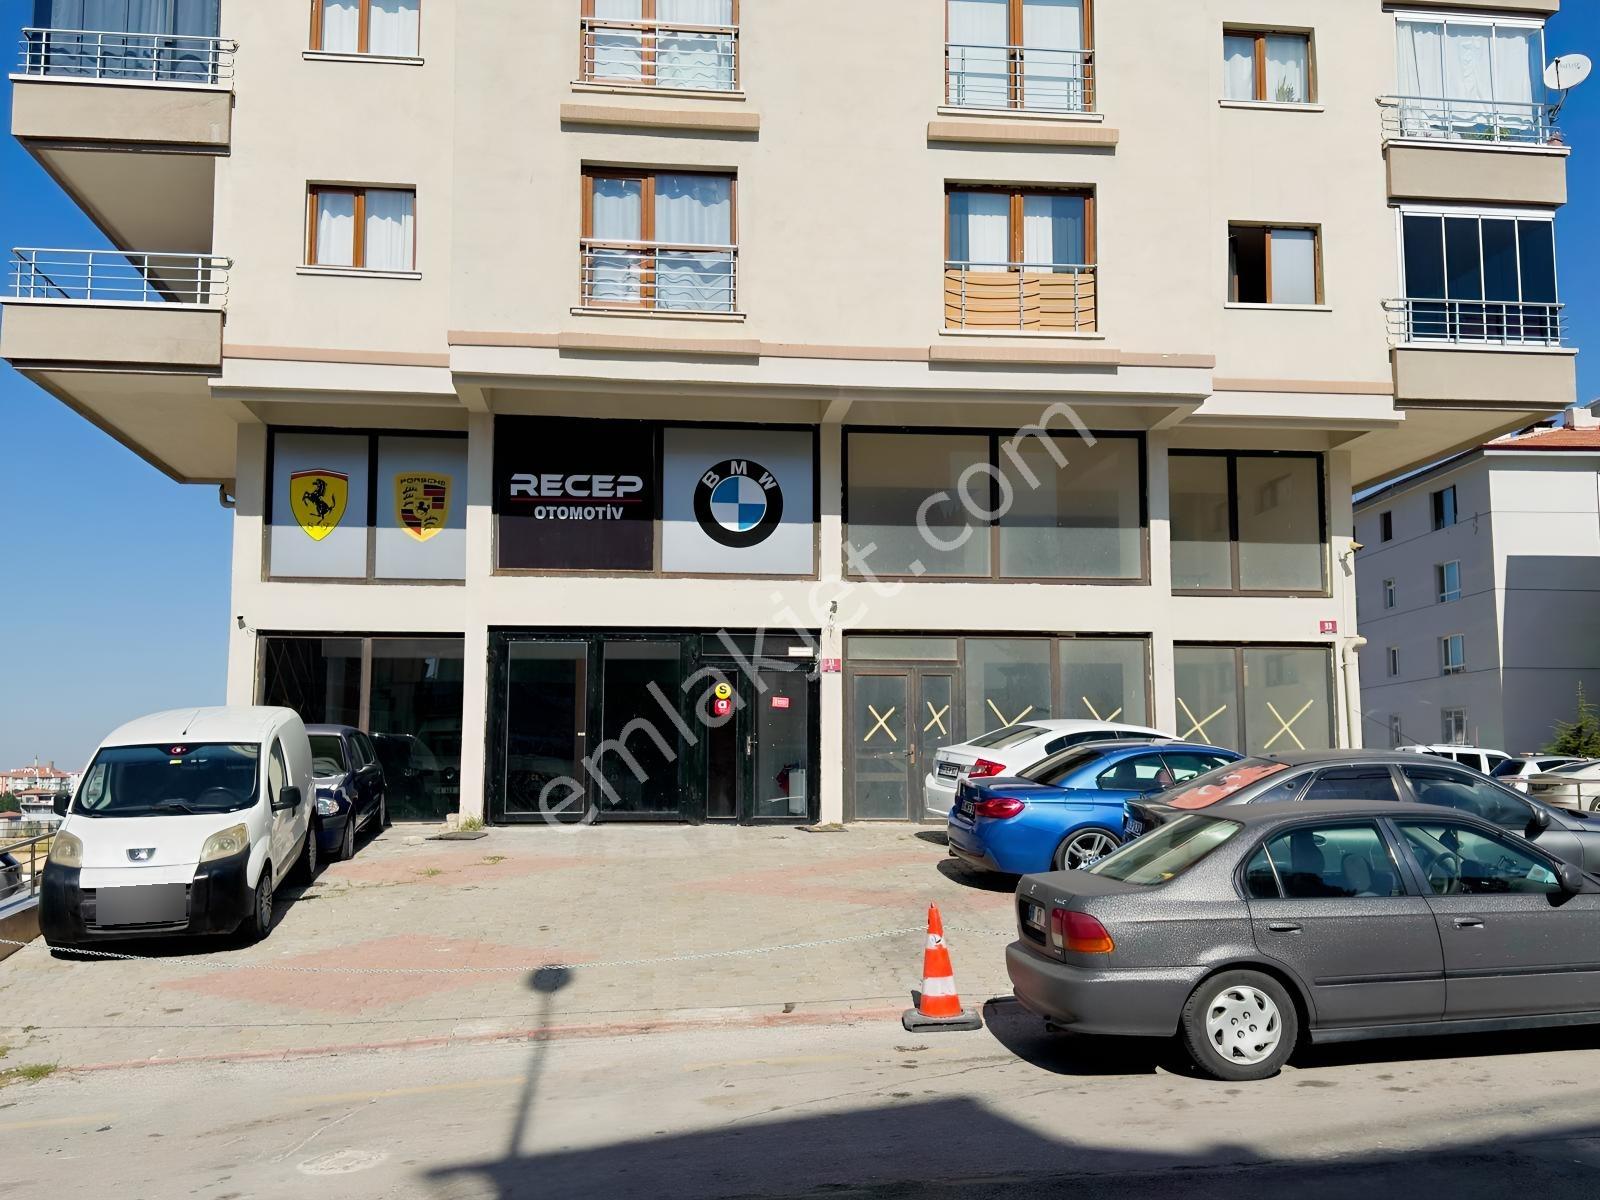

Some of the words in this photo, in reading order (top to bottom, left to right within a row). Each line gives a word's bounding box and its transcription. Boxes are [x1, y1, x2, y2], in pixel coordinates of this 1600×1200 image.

[510, 473, 643, 497] RECEP
[702, 461, 777, 489] BMW
[534, 503, 624, 520] OTOMOTİV
